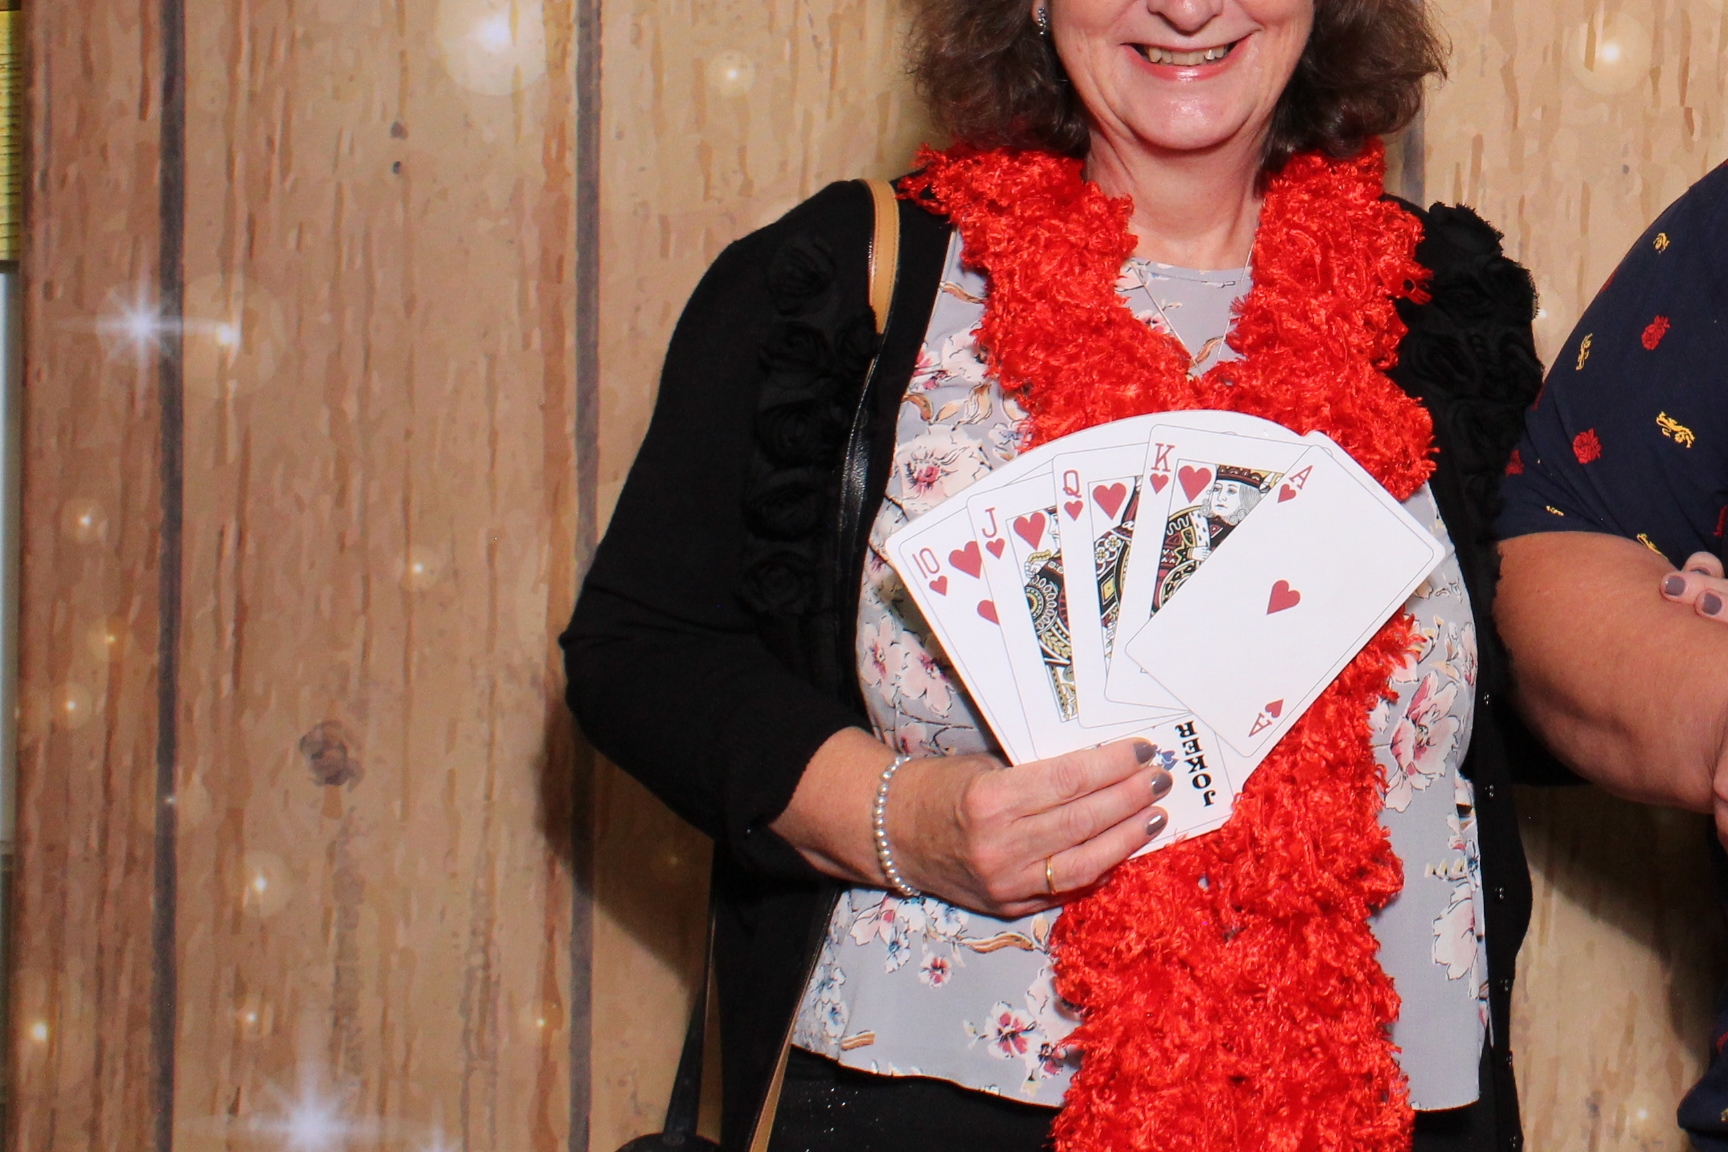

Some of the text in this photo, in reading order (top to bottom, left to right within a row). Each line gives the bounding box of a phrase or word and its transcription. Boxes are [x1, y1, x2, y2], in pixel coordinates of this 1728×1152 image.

[1150, 442, 1176, 473] K
[1062, 468, 1083, 499] Q
[1288, 464, 1314, 491] A
[981, 506, 997, 539] J
[911, 546, 941, 580] 10
[1247, 711, 1274, 738] A
[1174, 719, 1217, 808] JOKER
